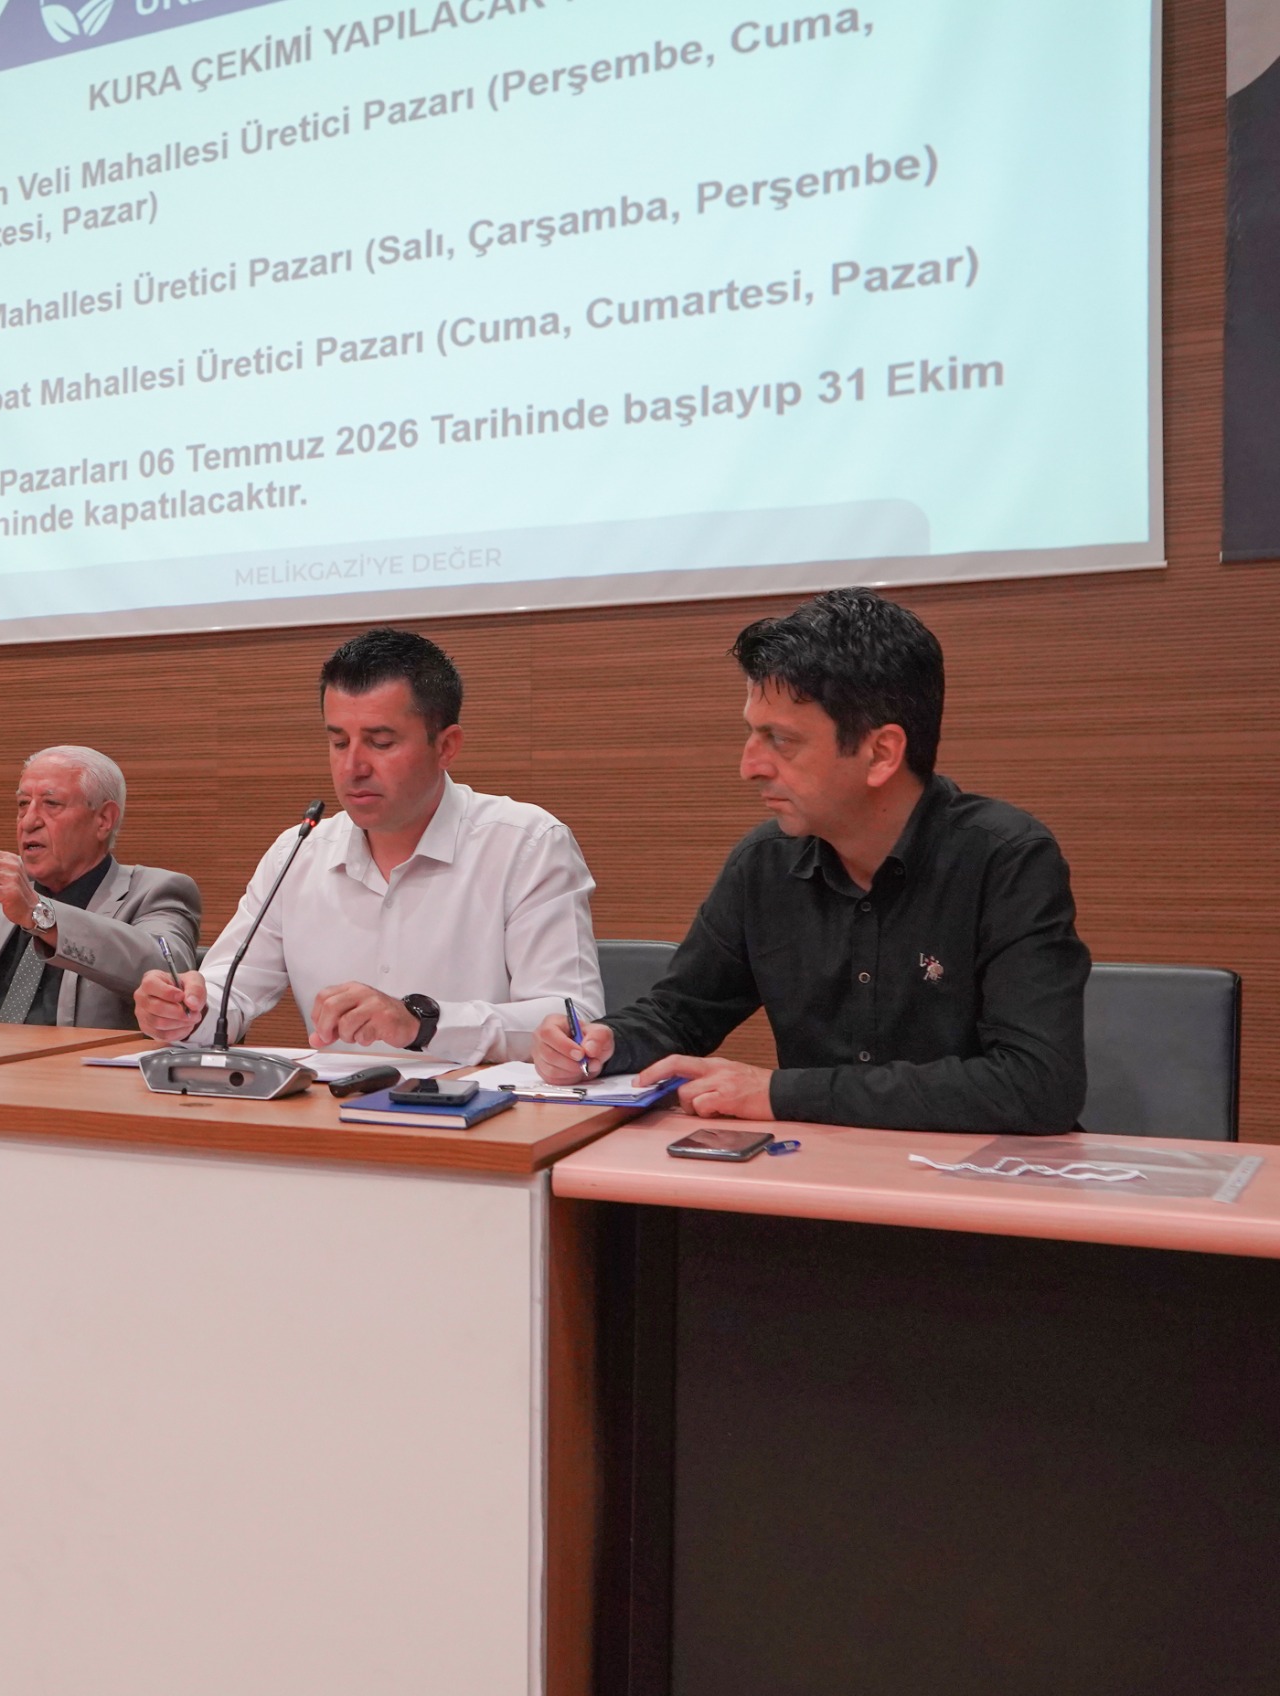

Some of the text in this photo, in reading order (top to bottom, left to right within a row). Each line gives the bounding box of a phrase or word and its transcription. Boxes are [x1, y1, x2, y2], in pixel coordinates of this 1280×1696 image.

[17, 165, 71, 201] Veli
[81, 131, 229, 189] Mahallesi
[240, 105, 350, 155] Üretici
[363, 86, 474, 131] Pazarı
[487, 39, 715, 113] (Perşembe,
[730, 7, 874, 55] Cuma,
[89, 64, 183, 112] KURA
[190, 25, 312, 93] ÇEKİMİ
[62, 190, 158, 235] Pazar)
[133, 261, 237, 306] Üretici
[249, 249, 352, 288] Pazarı
[365, 228, 455, 275] (Salı,
[468, 195, 680, 258] Çarşamba,
[696, 143, 939, 215] Perşembe)
[40, 358, 185, 406] Mahallesi
[196, 340, 303, 383] Üretici
[316, 330, 424, 367] Pazarı
[436, 311, 572, 358] (Cuma,
[585, 269, 814, 329] Cumartesi,
[831, 245, 979, 296] Pazar)
[0, 457, 128, 497] Pazarları
[138, 447, 175, 479] 06
[185, 435, 325, 473] Temmuz
[335, 418, 419, 456] 2026
[430, 398, 609, 445] Tarihinde
[623, 381, 802, 428] başlayıp
[817, 366, 865, 405] 31
[887, 355, 1004, 398] Ekim
[84, 480, 308, 531] kapatılacaktır.
[234, 546, 503, 587] MELİKGAZİ'YE DEĞER
